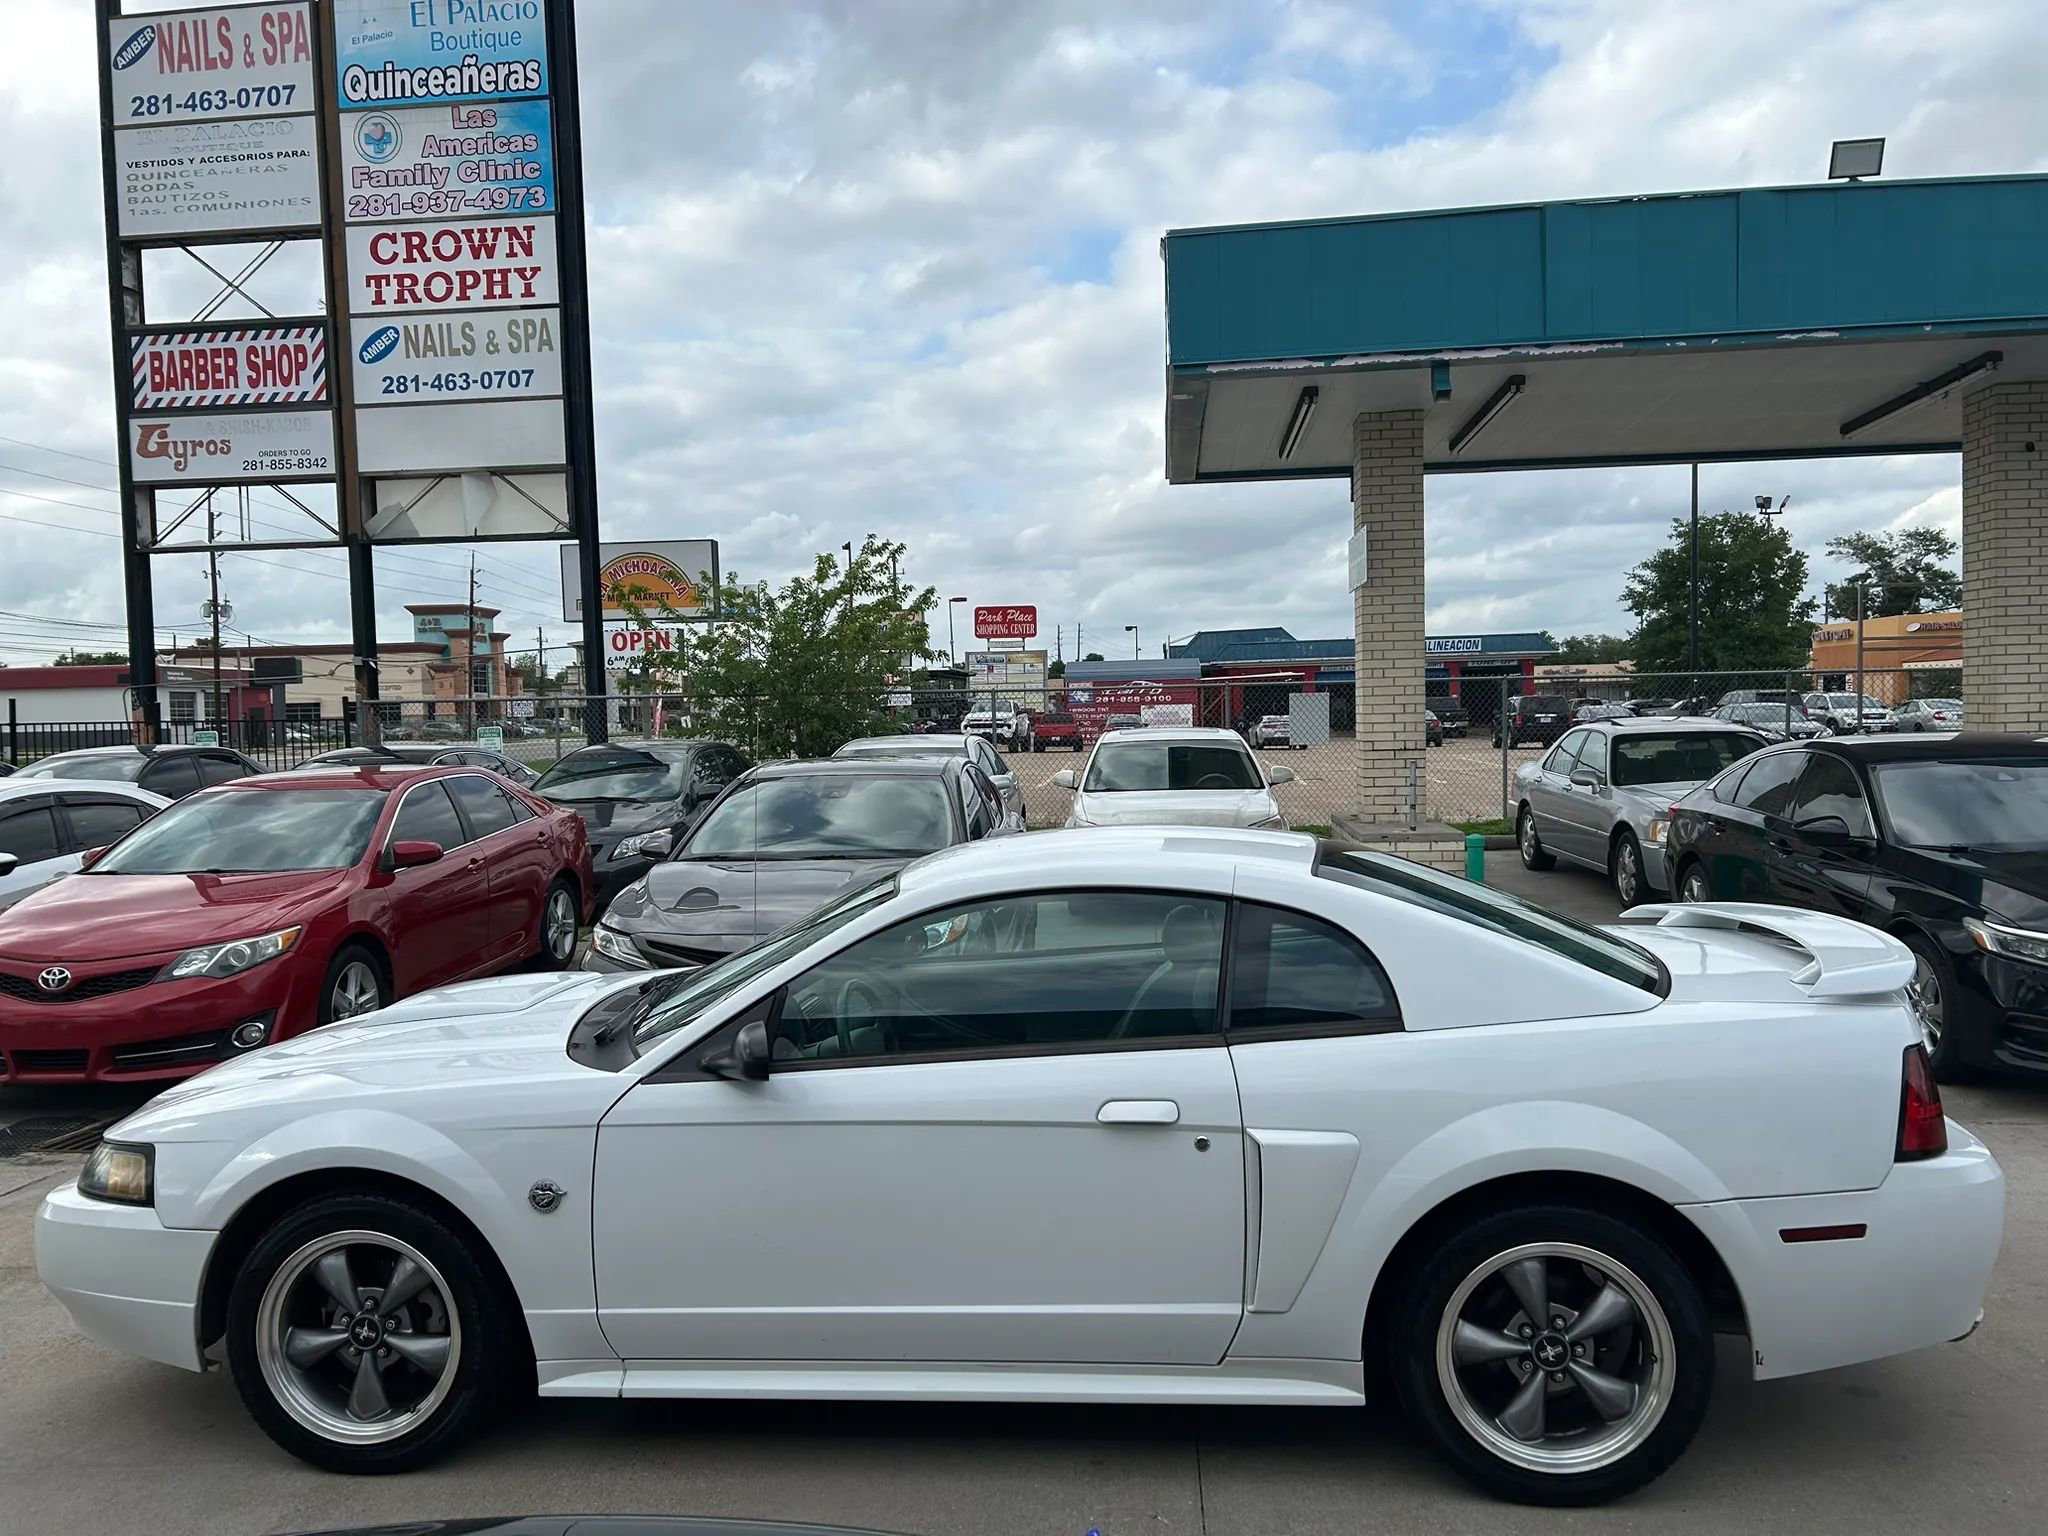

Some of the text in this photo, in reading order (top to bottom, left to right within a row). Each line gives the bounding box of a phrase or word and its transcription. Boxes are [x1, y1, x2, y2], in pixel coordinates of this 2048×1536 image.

[116, 26, 156, 69] AMBER
[156, 10, 311, 74] NAILS & SPA
[351, 30, 393, 45] El Palacio
[430, 29, 522, 52] Boutique
[343, 54, 541, 102] Quinceañeras
[131, 84, 296, 117] 281-463-0707
[452, 106, 497, 129] Las
[421, 132, 538, 158] Americas
[126, 150, 311, 169] VESTIDOS Y ACCESORIOS PARA:
[352, 158, 542, 189] Family Clinic
[126, 181, 194, 194] BODAS
[127, 190, 229, 205] BAUTIZOS
[173, 197, 312, 213] COMUNIONES
[349, 186, 546, 217] 281-937-4973
[369, 225, 536, 265] CROWN
[365, 266, 542, 306] TROPHY
[360, 328, 399, 363] AMBER
[403, 317, 554, 359] NAILS & SPA
[149, 343, 308, 393] BARBER SHOP
[381, 369, 535, 394] 281-463-0707
[136, 423, 231, 472] Gyros
[242, 457, 327, 471] 281-855-8342
[634, 592, 670, 601] MARKET
[977, 609, 1034, 622] Park Place
[611, 631, 671, 651] OPEN
[976, 623, 1035, 635] SHOPPING CENTER
